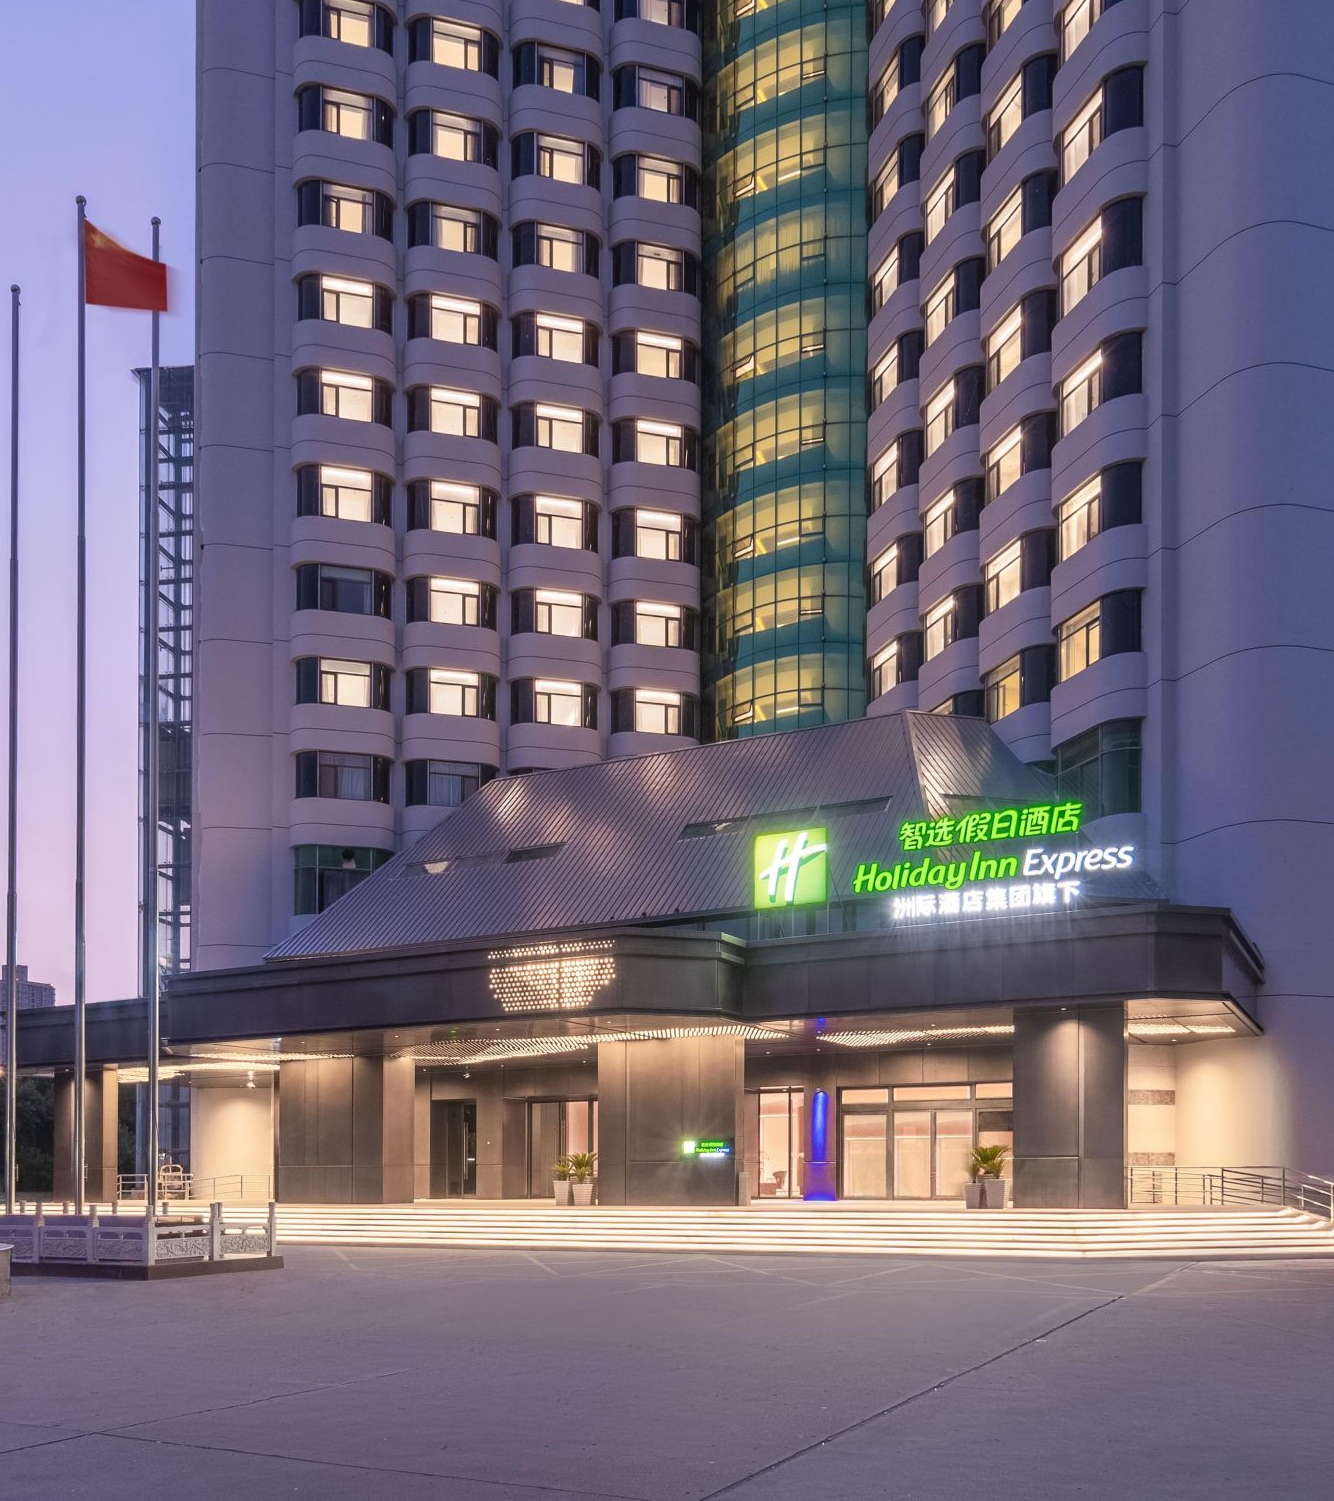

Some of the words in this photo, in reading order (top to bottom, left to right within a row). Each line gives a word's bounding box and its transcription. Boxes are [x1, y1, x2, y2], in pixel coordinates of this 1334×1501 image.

[898, 802, 1082, 850] 智选假日酒店
[853, 856, 965, 893] Holiday
[968, 851, 1018, 881] Inn
[1023, 846, 1134, 880] Express
[893, 881, 1081, 919] 洲际酒店集团旗下
